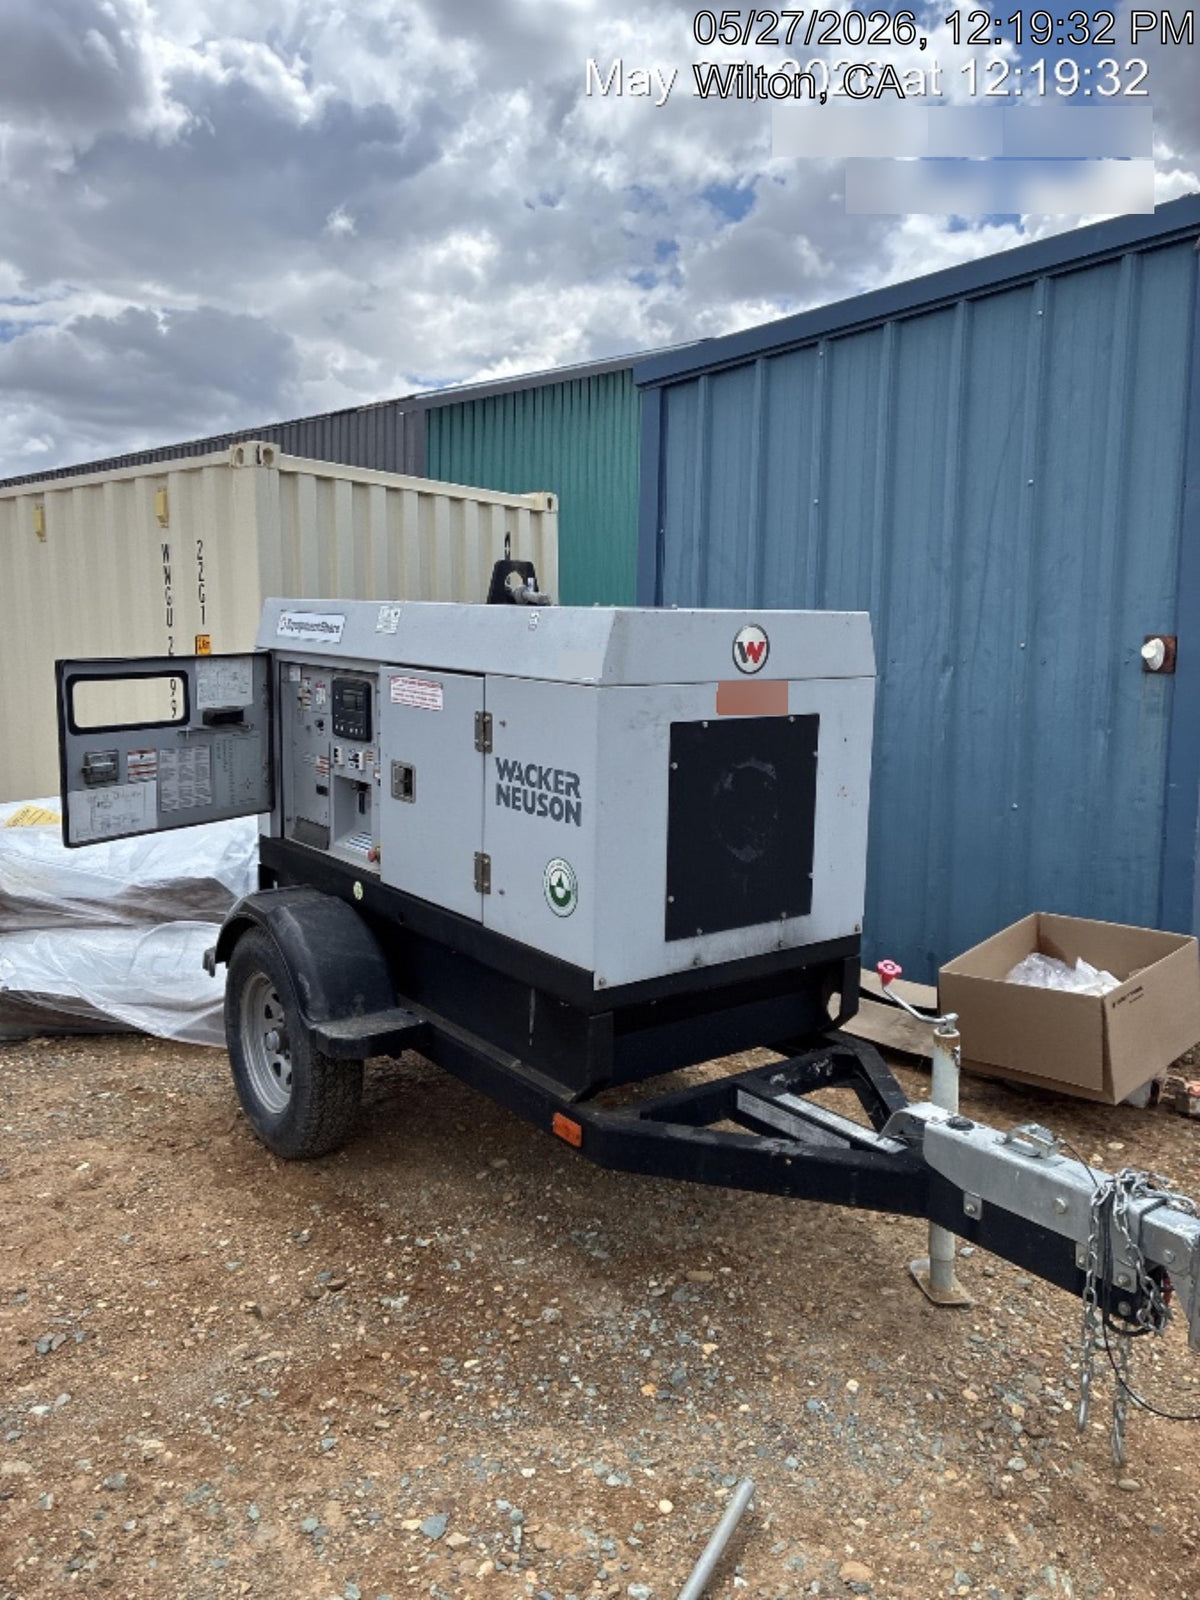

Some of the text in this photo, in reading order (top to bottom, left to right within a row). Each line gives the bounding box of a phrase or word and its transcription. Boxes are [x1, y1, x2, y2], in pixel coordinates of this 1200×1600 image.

[196, 539, 205, 625] 22G1
[495, 756, 582, 799] WACKER
[495, 782, 582, 827] NEUSON
